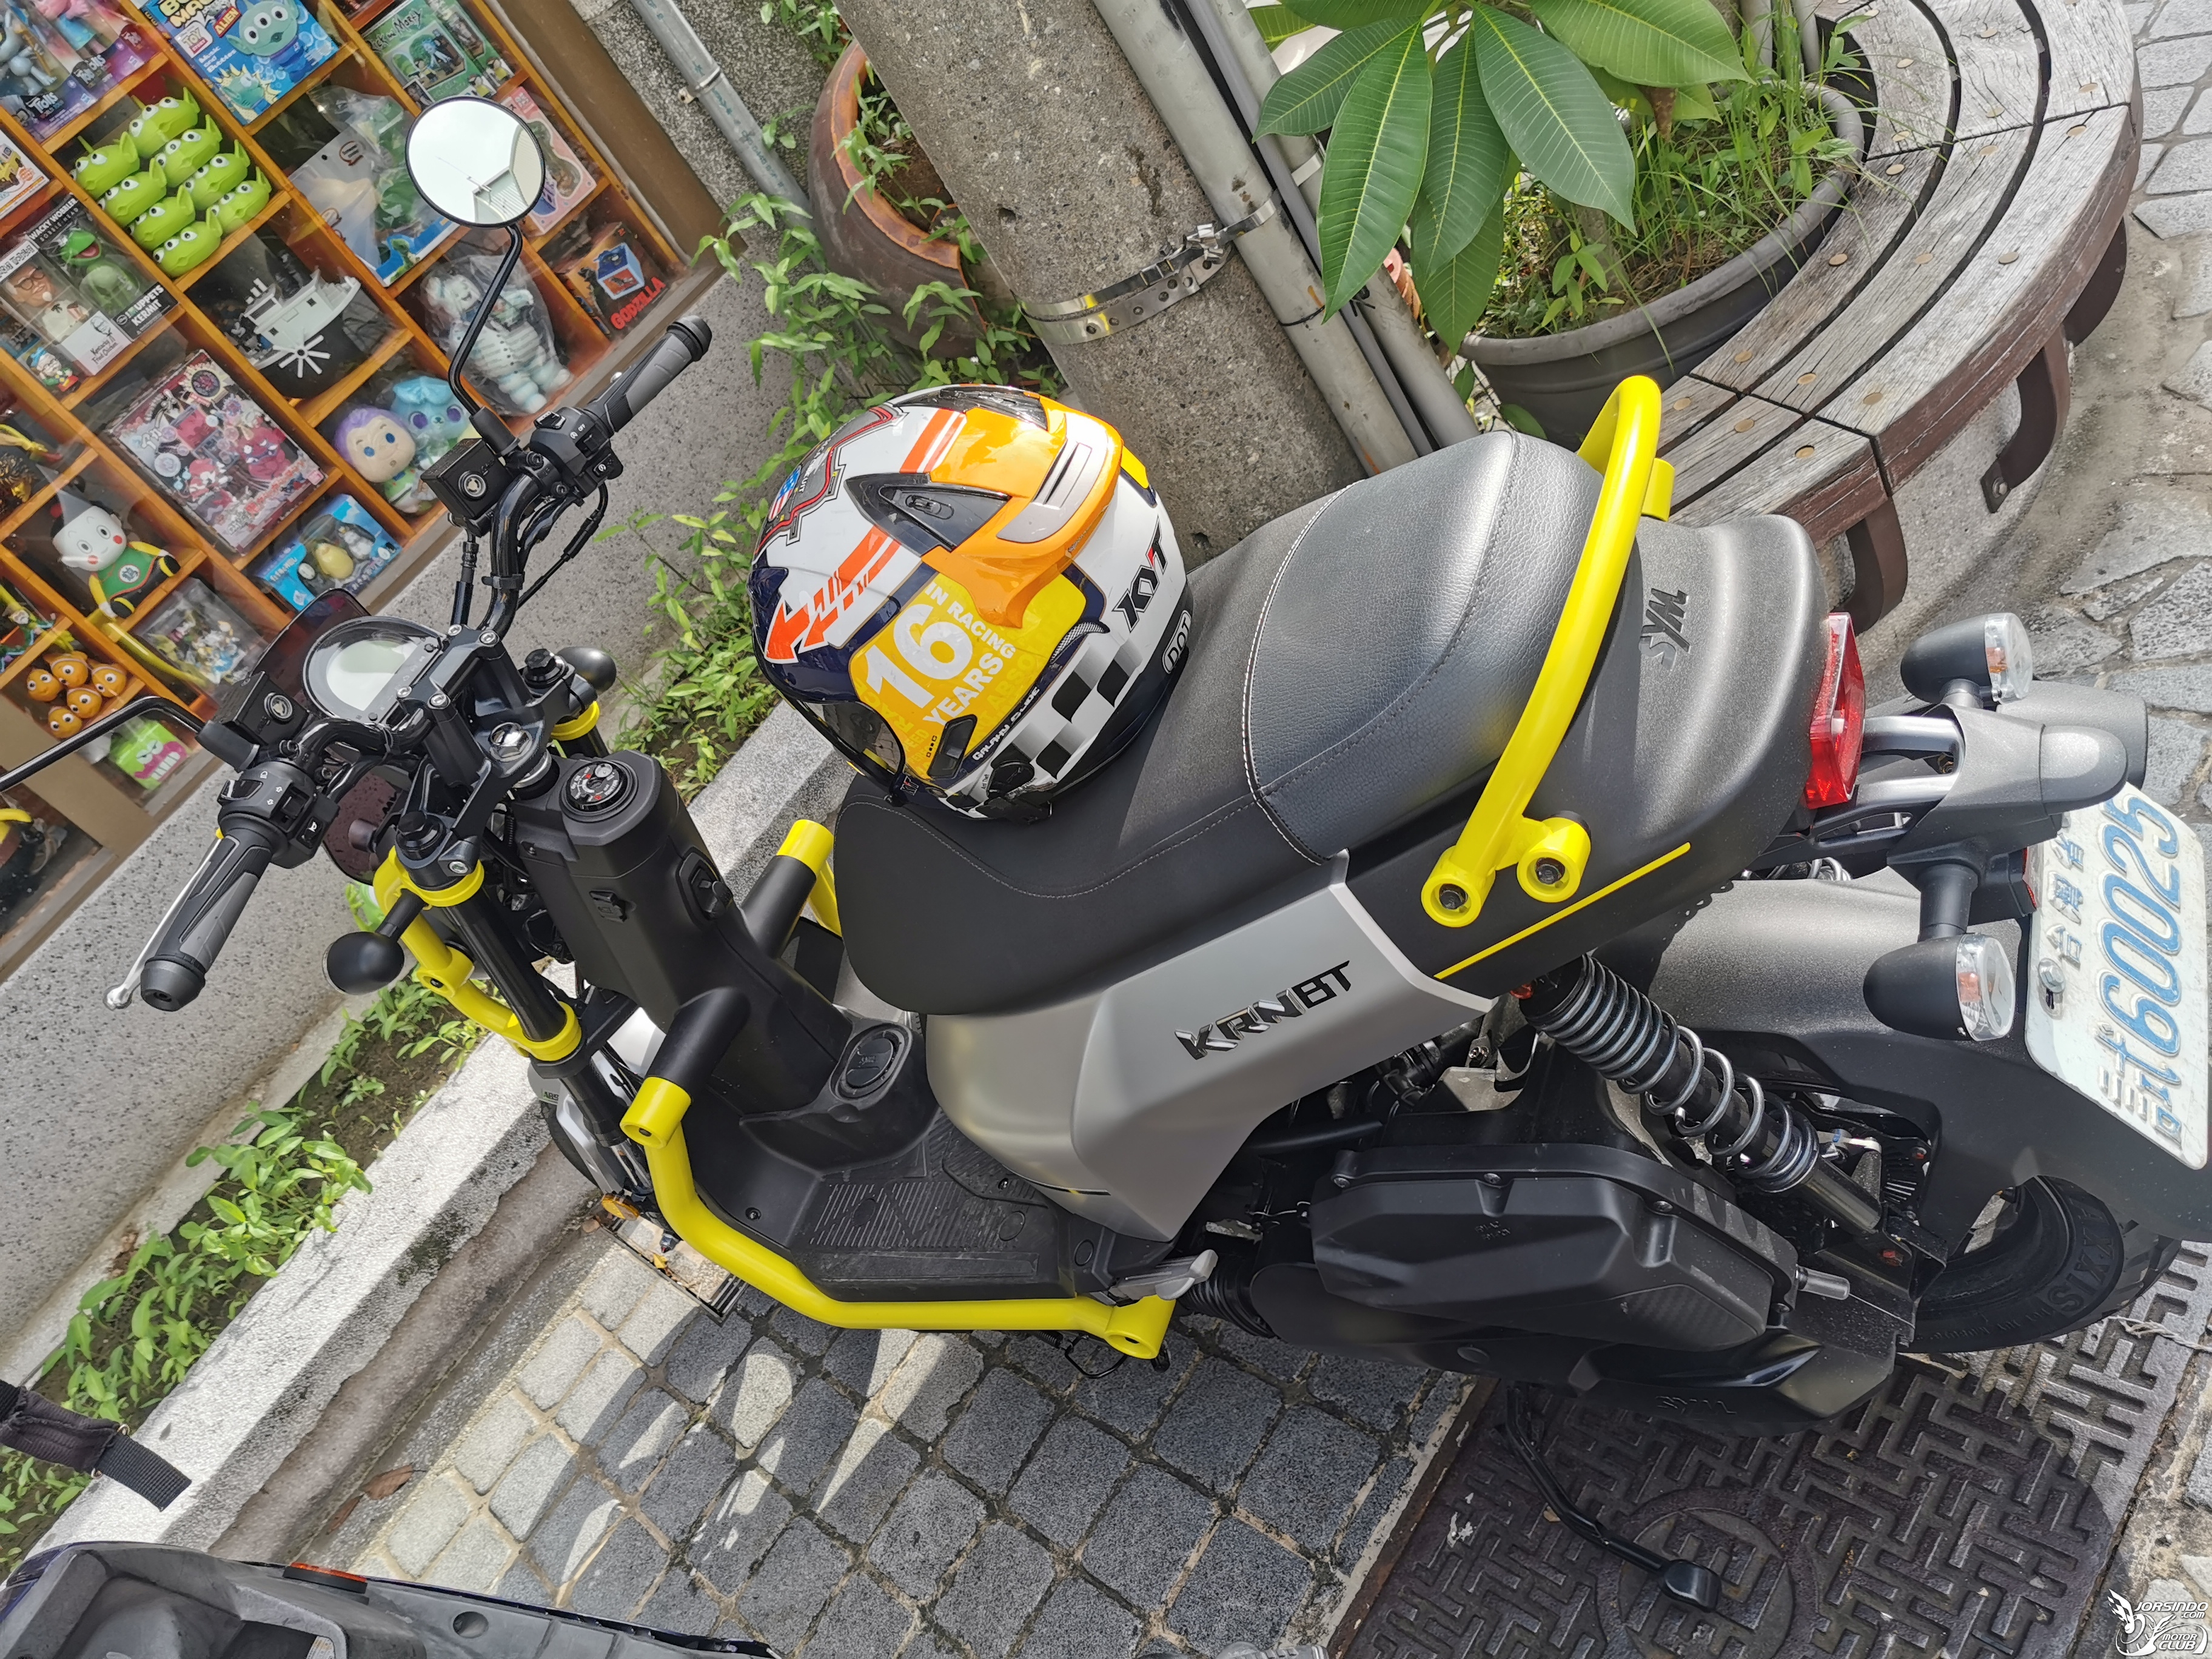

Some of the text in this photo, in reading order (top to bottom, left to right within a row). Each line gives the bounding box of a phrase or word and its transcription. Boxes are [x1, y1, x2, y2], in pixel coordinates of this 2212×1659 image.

[214, 7, 239, 36] ALIEN
[182, 27, 203, 46] TOY
[198, 46, 221, 64] Music
[207, 49, 237, 73] Bubbles
[25, 92, 59, 114] Trolls
[29, 219, 52, 241] WACKY
[50, 197, 78, 223] WOBBLER
[131, 298, 162, 327] KERMIT
[611, 276, 666, 330] GODZILLA
[577, 423, 586, 432] OFF
[1112, 515, 1168, 633] KYT
[923, 581, 1016, 659] IN RACING
[1167, 617, 1190, 666] DOT
[865, 604, 973, 709] 16
[922, 652, 1004, 726] YEARS
[900, 774, 919, 796] KYT
